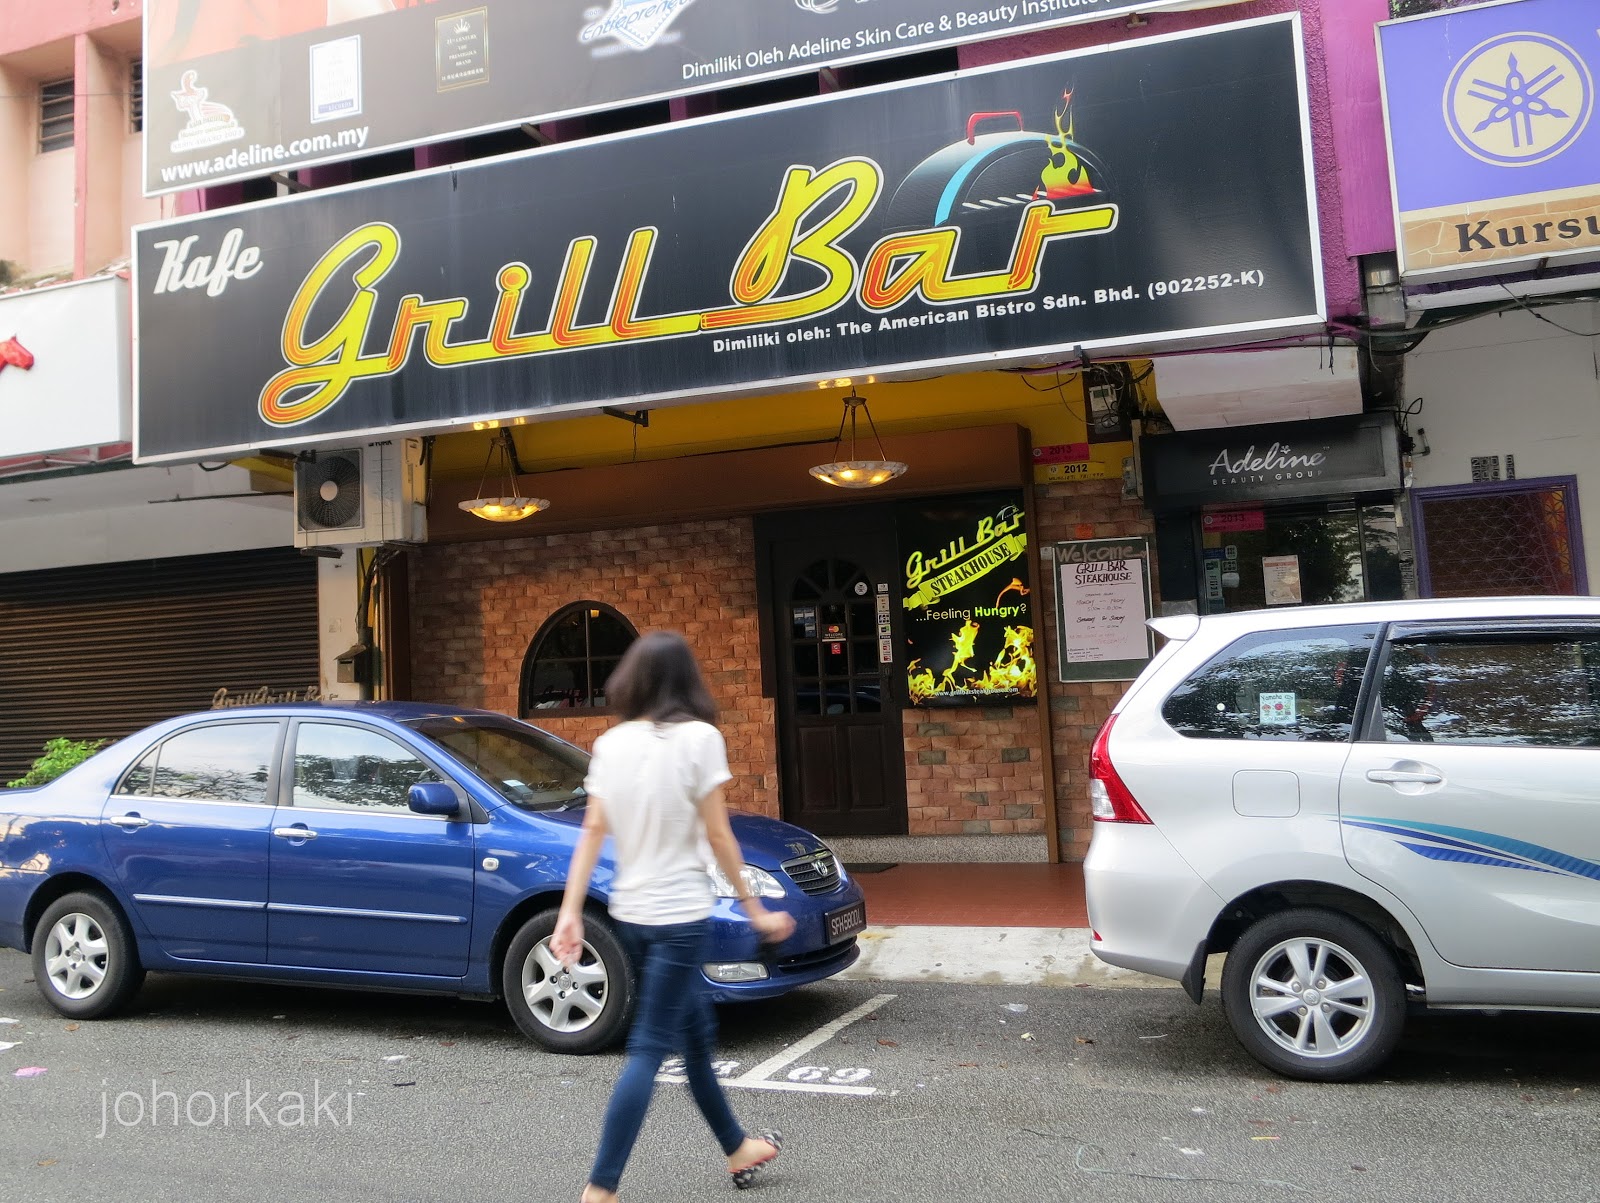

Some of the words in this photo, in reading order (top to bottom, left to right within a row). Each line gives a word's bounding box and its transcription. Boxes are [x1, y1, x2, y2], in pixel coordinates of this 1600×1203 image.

[682, 54, 742, 80] Dimiliki
[745, 47, 784, 67] Oleh
[788, 37, 851, 60] Adeline
[855, 29, 892, 48] Skin
[895, 19, 940, 40] Care
[938, 15, 953, 31] &
[956, 3, 1017, 29] Beauty
[161, 126, 369, 182] www.adeline.com.my
[153, 227, 263, 296] Kafe
[258, 221, 702, 427] Grill
[700, 156, 1118, 332] Bar
[713, 331, 780, 353] Dimiliki
[786, 327, 831, 343] oleh:
[837, 321, 872, 336] The
[878, 304, 969, 331] American
[976, 300, 1036, 318] Bistro
[1043, 293, 1087, 310] Sdn.
[1094, 286, 1140, 304] Bhd.
[1147, 269, 1265, 300] (902252-K)
[1064, 463, 1088, 474] 2012
[1208, 442, 1327, 475] Adeline
[1213, 474, 1264, 486] BEAUTY
[1275, 470, 1323, 481] GROUP
[1221, 513, 1245, 523] 2013
[906, 536, 966, 589] Grill
[972, 511, 1025, 550] Bar
[1056, 543, 1140, 563] Welcome
[930, 542, 1012, 596] STEAKHOUSE
[1074, 571, 1133, 585] STEAKHOUSE
[1076, 561, 1107, 575] GRILL
[1107, 559, 1129, 572] BAR
[974, 603, 1027, 619] Hungry?
[787, 1065, 872, 1083] 69
